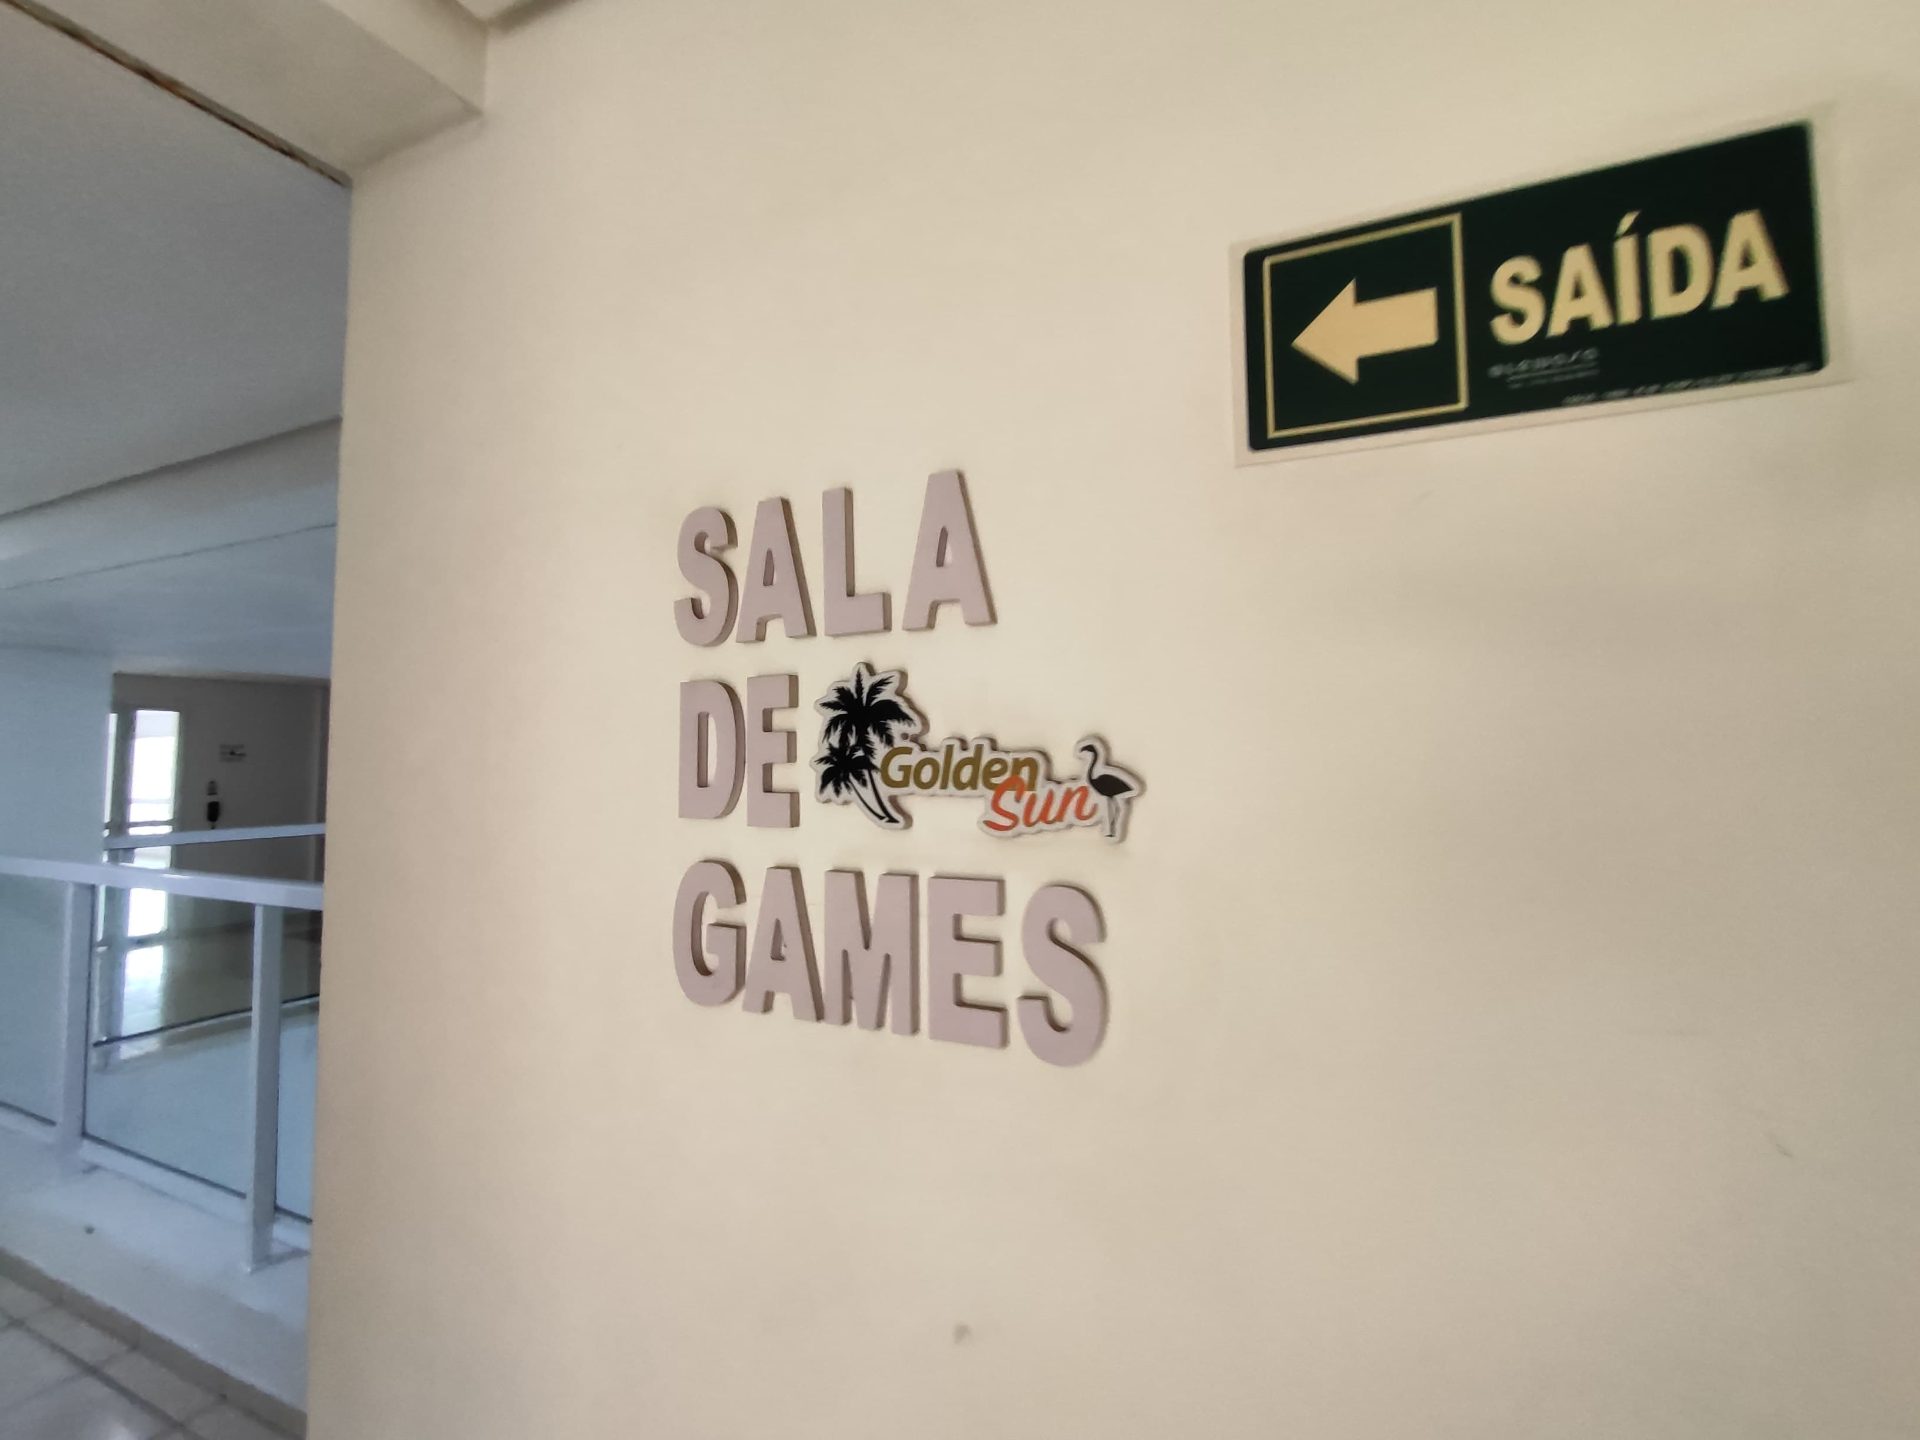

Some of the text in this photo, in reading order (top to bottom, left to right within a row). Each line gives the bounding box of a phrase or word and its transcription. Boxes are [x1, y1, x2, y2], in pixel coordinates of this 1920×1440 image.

[1489, 209, 1789, 346] SAÍDA
[673, 469, 997, 647] SALA
[678, 673, 800, 828] DE
[880, 744, 1039, 791] Golden
[982, 775, 1098, 832] Sun
[672, 859, 1107, 1067] GAMES
